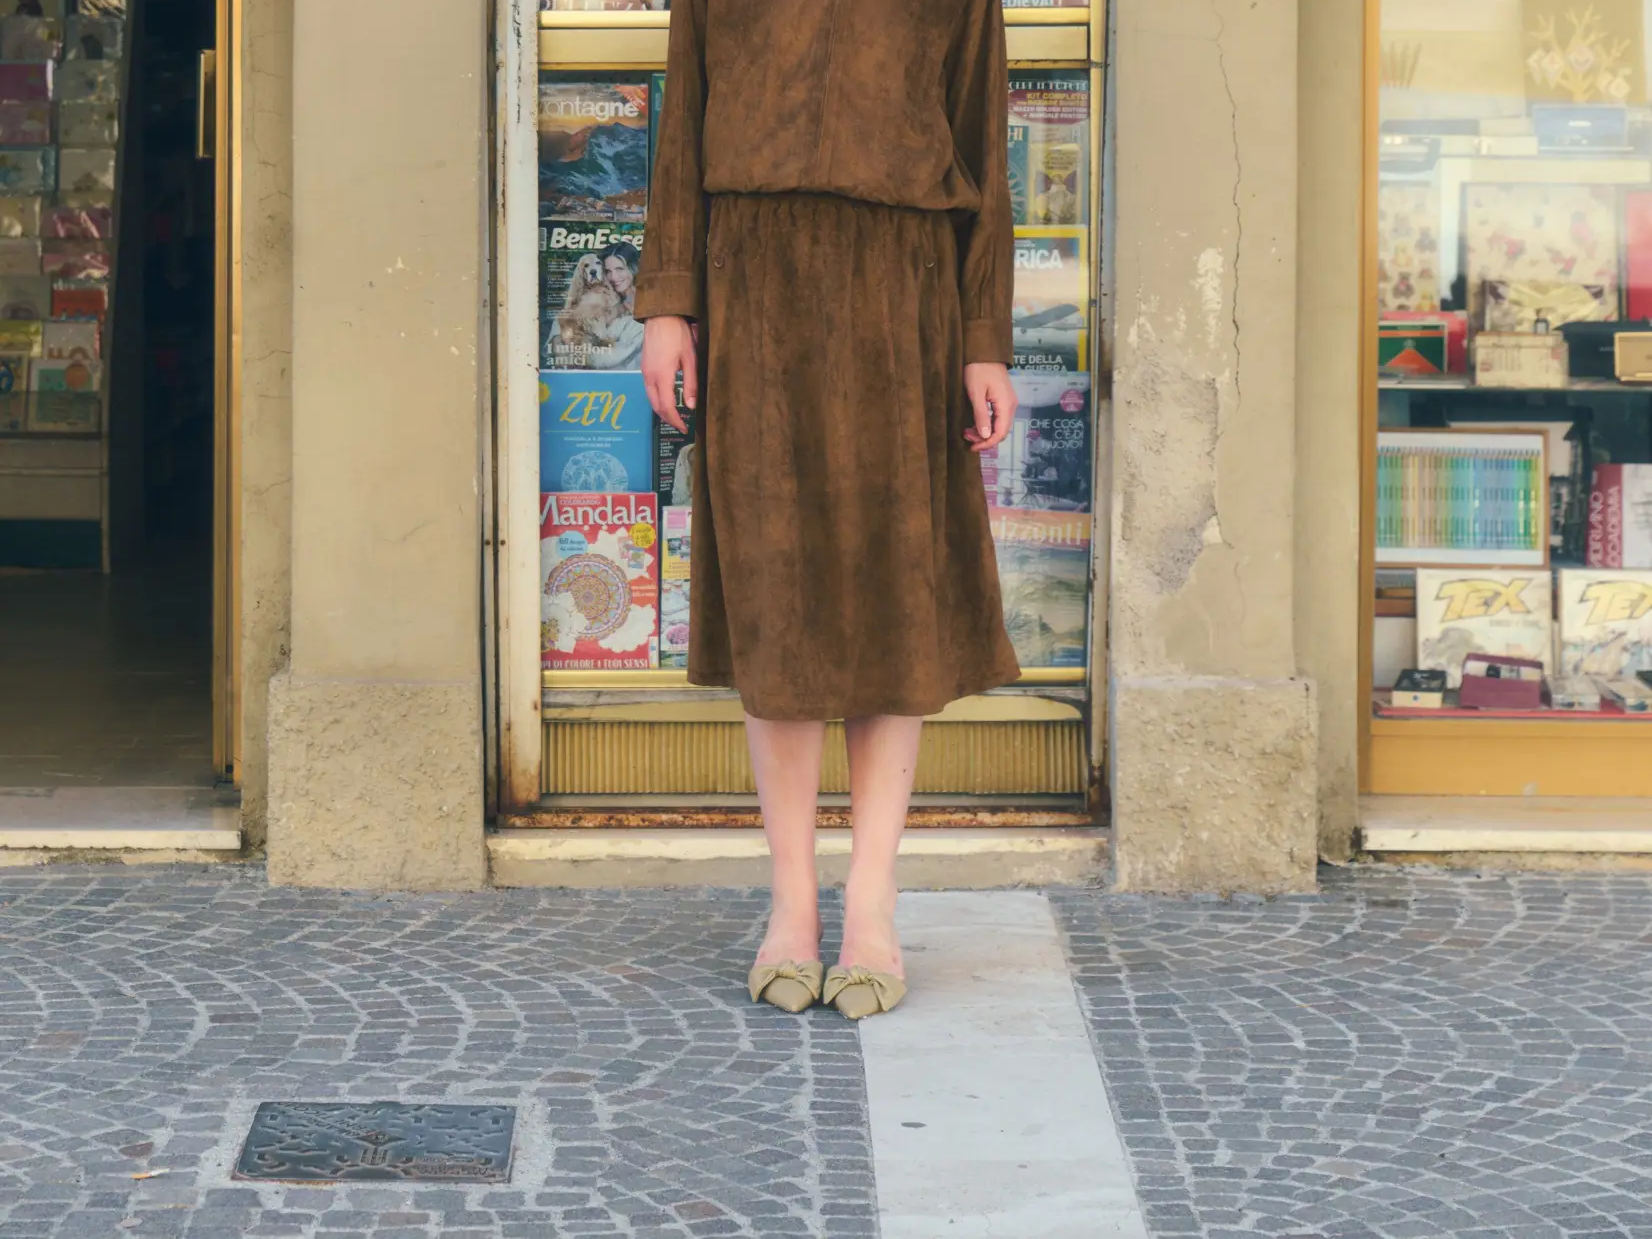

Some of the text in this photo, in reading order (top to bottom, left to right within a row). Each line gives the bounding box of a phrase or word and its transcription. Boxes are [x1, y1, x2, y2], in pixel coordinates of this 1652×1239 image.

[550, 228, 644, 250] BenEsse
[1014, 249, 1063, 269] RICA
[555, 341, 613, 357] migliori
[546, 354, 586, 366] amici
[1029, 355, 1063, 364] DELLA
[559, 391, 627, 431] ZEN
[1030, 418, 1085, 429] CHE COSA
[1588, 490, 1604, 568] ABRIANO
[1606, 485, 1621, 568] CCADEMIA
[1434, 578, 1533, 624] TEX
[624, 658, 648, 667] SENSI
